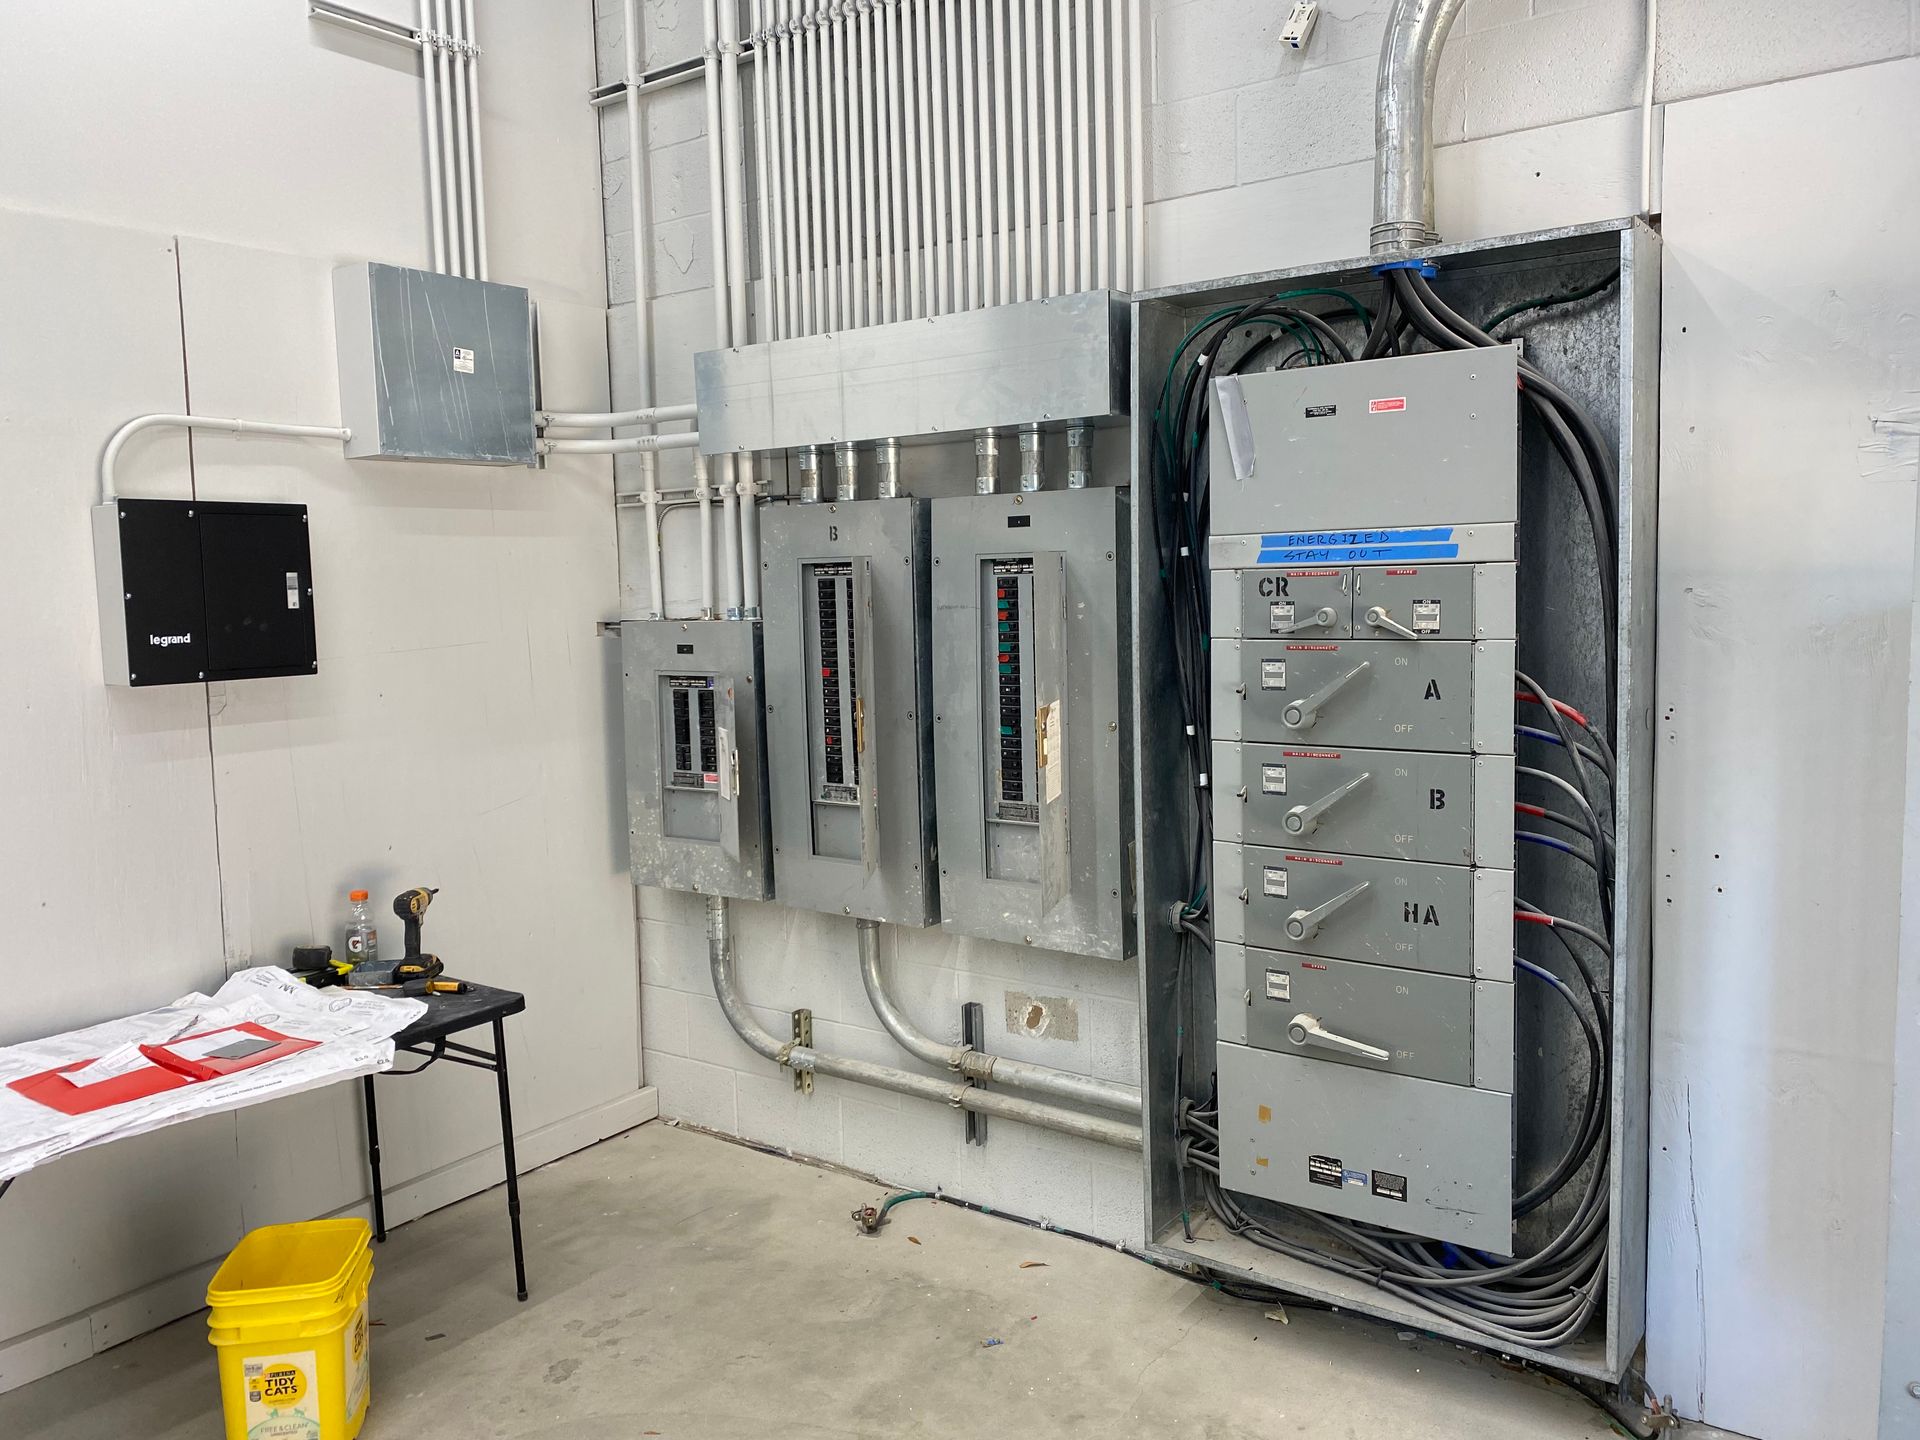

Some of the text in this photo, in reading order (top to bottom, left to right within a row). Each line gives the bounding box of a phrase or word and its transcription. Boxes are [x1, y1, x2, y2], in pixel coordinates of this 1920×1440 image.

[829, 525, 838, 542] B
[1288, 531, 1390, 545] ENERGIZED
[1283, 549, 1392, 560] STAY OUT
[1258, 577, 1289, 597] CR
[149, 633, 191, 647] legrand
[1394, 657, 1408, 667] ON
[1424, 679, 1441, 701] A
[1394, 723, 1414, 733] OFF
[1394, 768, 1408, 777] ON
[1429, 788, 1446, 810] B
[1394, 834, 1414, 844] OFF
[1394, 877, 1408, 886] ON
[1403, 902, 1440, 927] HA
[348, 936, 362, 952] G
[1395, 943, 1414, 952] OFF
[1395, 986, 1409, 995] ON
[1396, 1050, 1415, 1060] OFF
[265, 1377, 295, 1388] TIDY
[265, 1386, 297, 1396] CATS
[260, 1425, 278, 1433] FREE
[284, 1423, 307, 1431] CLEAN
